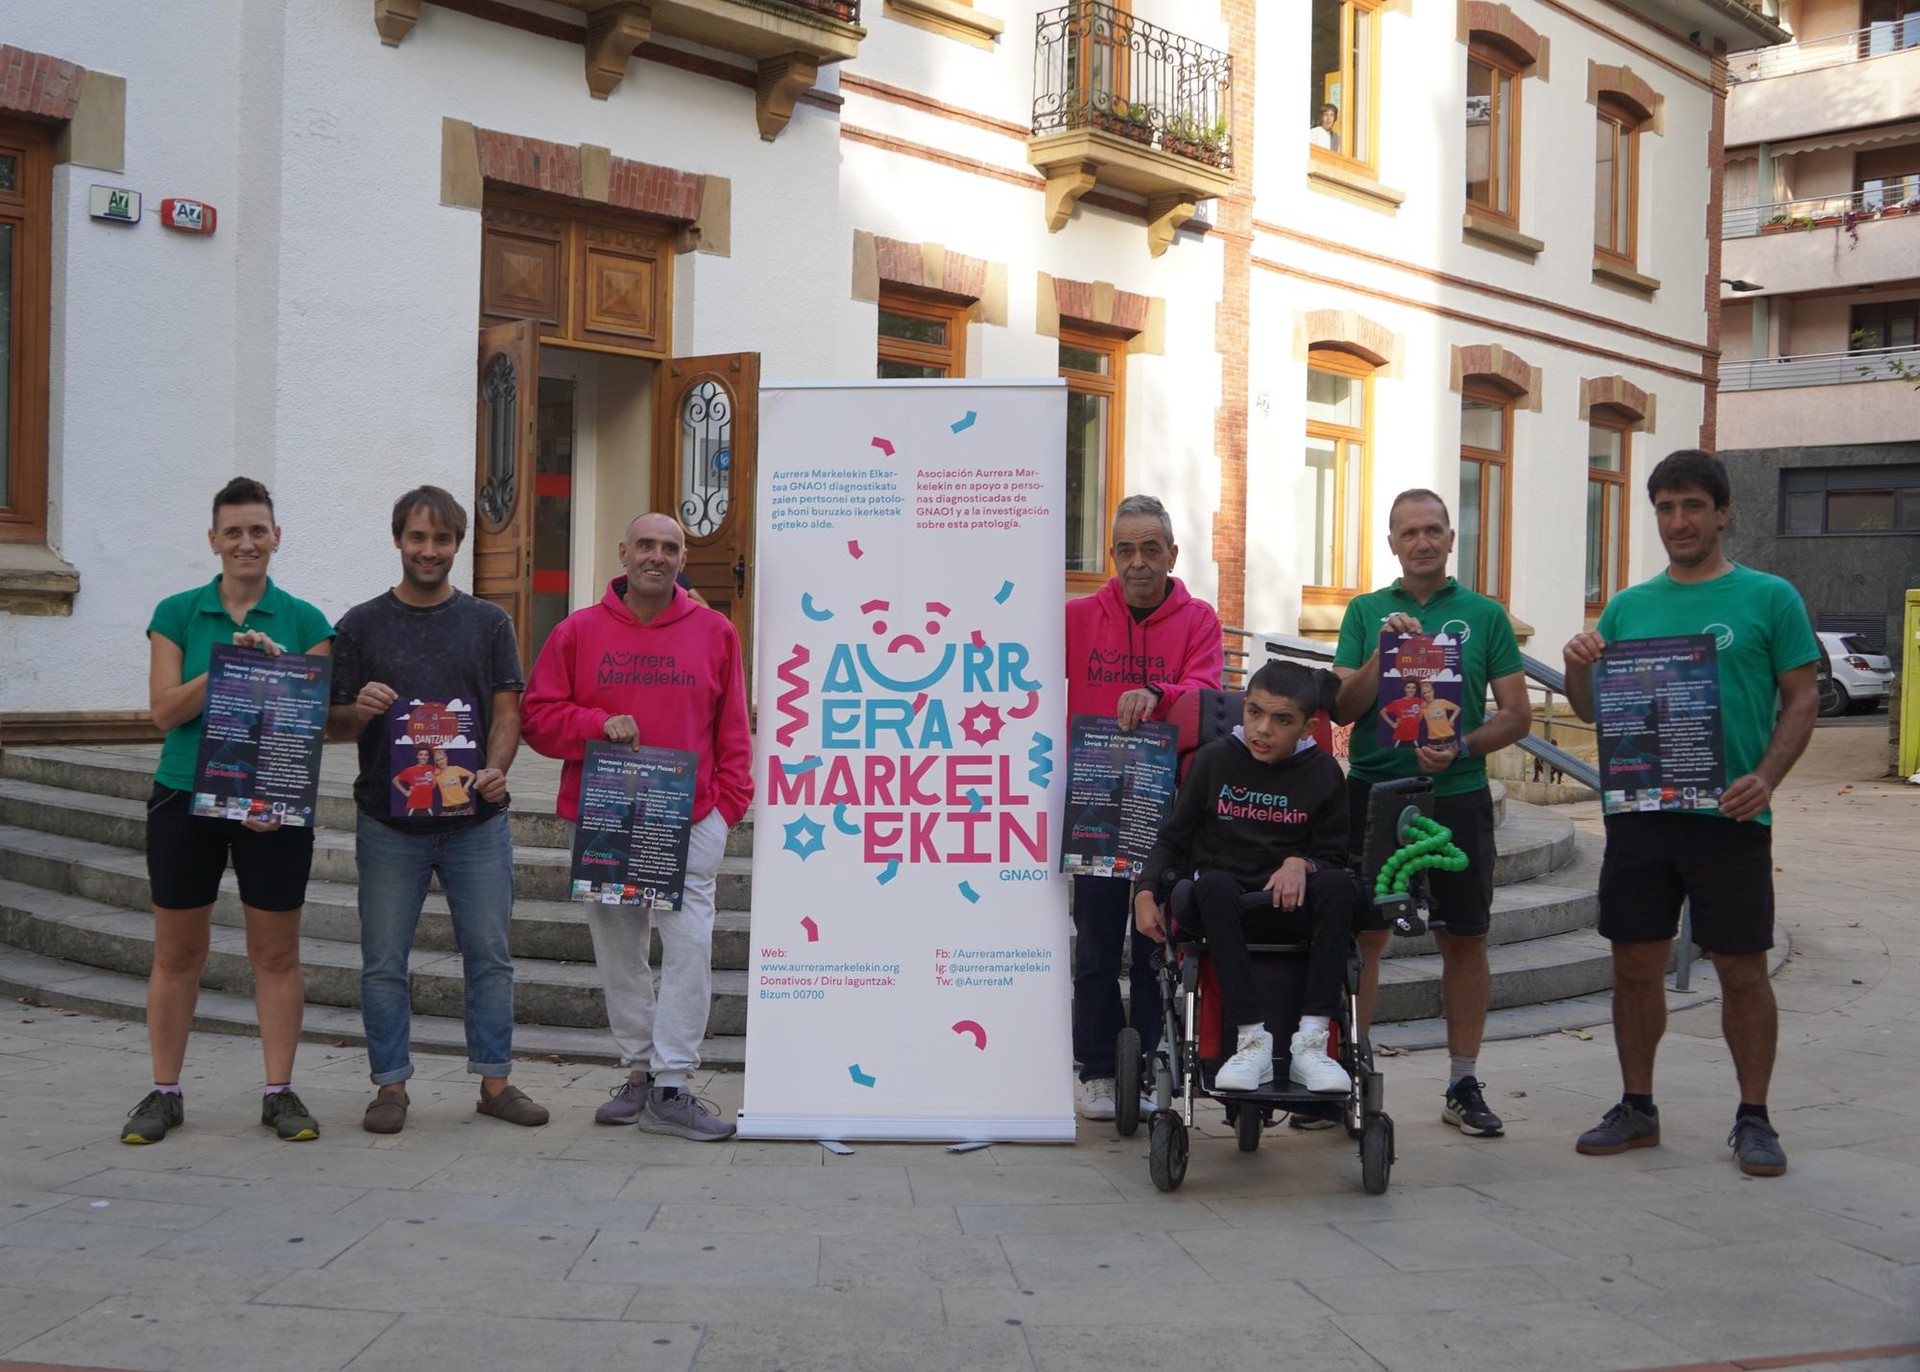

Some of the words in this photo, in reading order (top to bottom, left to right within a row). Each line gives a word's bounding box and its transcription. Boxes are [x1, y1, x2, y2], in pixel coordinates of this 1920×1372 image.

[773, 469, 809, 479] Aurrera
[812, 468, 868, 479] Markelekin
[869, 468, 899, 479] Elkar-
[917, 467, 973, 479] Asociación
[976, 468, 1013, 478] Aurrera
[1015, 468, 1040, 478] Mar-
[772, 483, 788, 492] tea
[828, 481, 897, 494] diagnostikatu
[917, 481, 954, 491] kelekin
[955, 483, 968, 491] en
[970, 483, 1001, 494] apoyo
[1011, 483, 1045, 494] perso-
[772, 494, 798, 505] zaien
[799, 494, 849, 506] pertsonei
[850, 495, 867, 504] eta
[868, 494, 906, 506] patolo-
[916, 495, 934, 504] nas
[935, 493, 1012, 506] diagnosticadas
[1013, 493, 1027, 503] de
[771, 507, 786, 520] gia
[787, 506, 810, 516] honi
[811, 507, 852, 517] buruzko
[854, 506, 901, 516] ikerketak
[972, 506, 981, 516] la
[982, 505, 1050, 519] investigación
[771, 519, 808, 532] egiteko
[810, 518, 835, 529] alde.
[916, 519, 945, 529] sobre
[947, 520, 969, 529] esta
[970, 518, 1021, 531] patología.
[597, 668, 697, 687] Markelekin
[1086, 665, 1178, 685] Markeleki
[768, 755, 1029, 806] MARKEL
[1217, 799, 1308, 824] Markelekin
[864, 812, 1048, 863] EKIN
[760, 948, 788, 958] Web:
[935, 949, 951, 958] Fb:
[760, 963, 900, 975] www.aurreramarkelekin.org
[935, 963, 947, 976] Ig:
[948, 963, 1051, 974] @aurreramarkelekin
[760, 976, 812, 986] Donativos
[820, 976, 843, 986] Diru
[844, 976, 896, 988] laguntzak:
[935, 976, 953, 986] Tw:
[954, 976, 1014, 988] @AurreraM
[760, 989, 791, 1000] Bizum
[793, 989, 825, 1000] 00700
